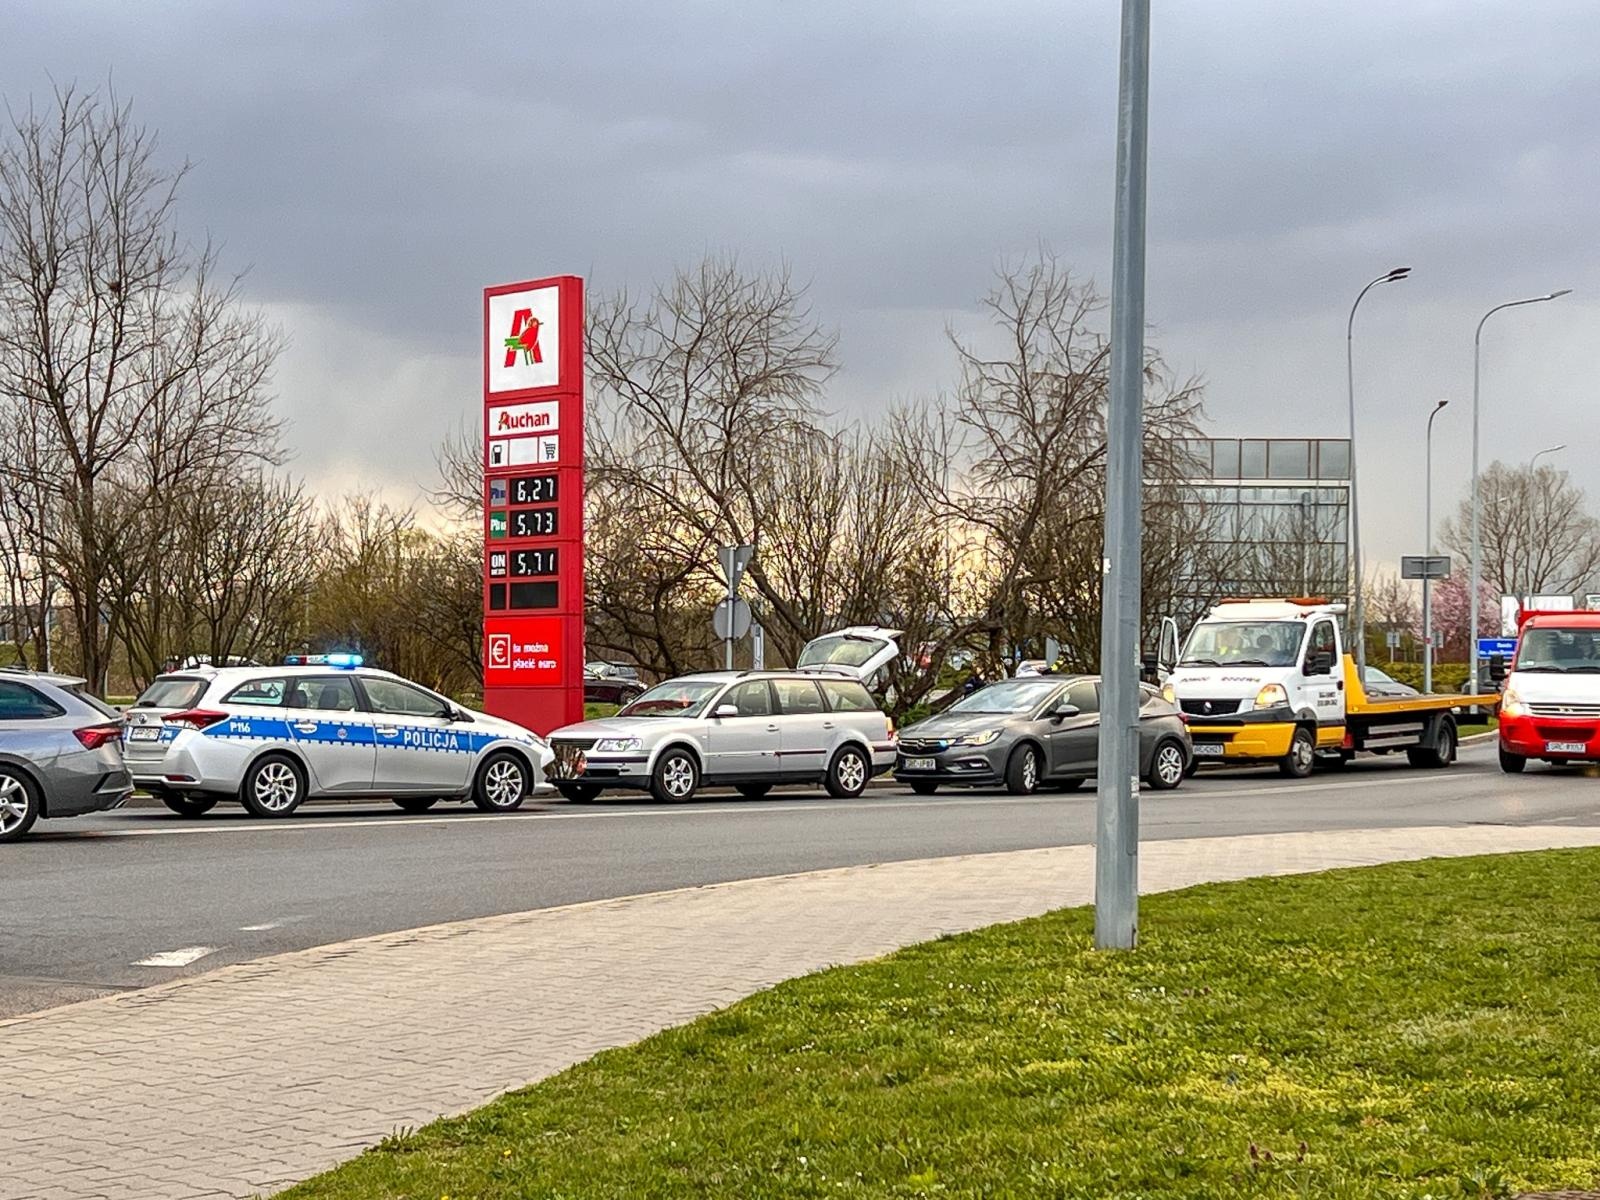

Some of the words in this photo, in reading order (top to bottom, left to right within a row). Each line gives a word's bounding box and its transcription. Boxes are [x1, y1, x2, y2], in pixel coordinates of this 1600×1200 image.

[499, 410, 550, 430] Auchan
[517, 478, 553, 502] 6,27
[517, 512, 553, 536] 5,73
[491, 554, 506, 567] ON
[518, 552, 554, 575] 5,71
[229, 721, 251, 733] P116
[403, 730, 459, 749] POLICJA
